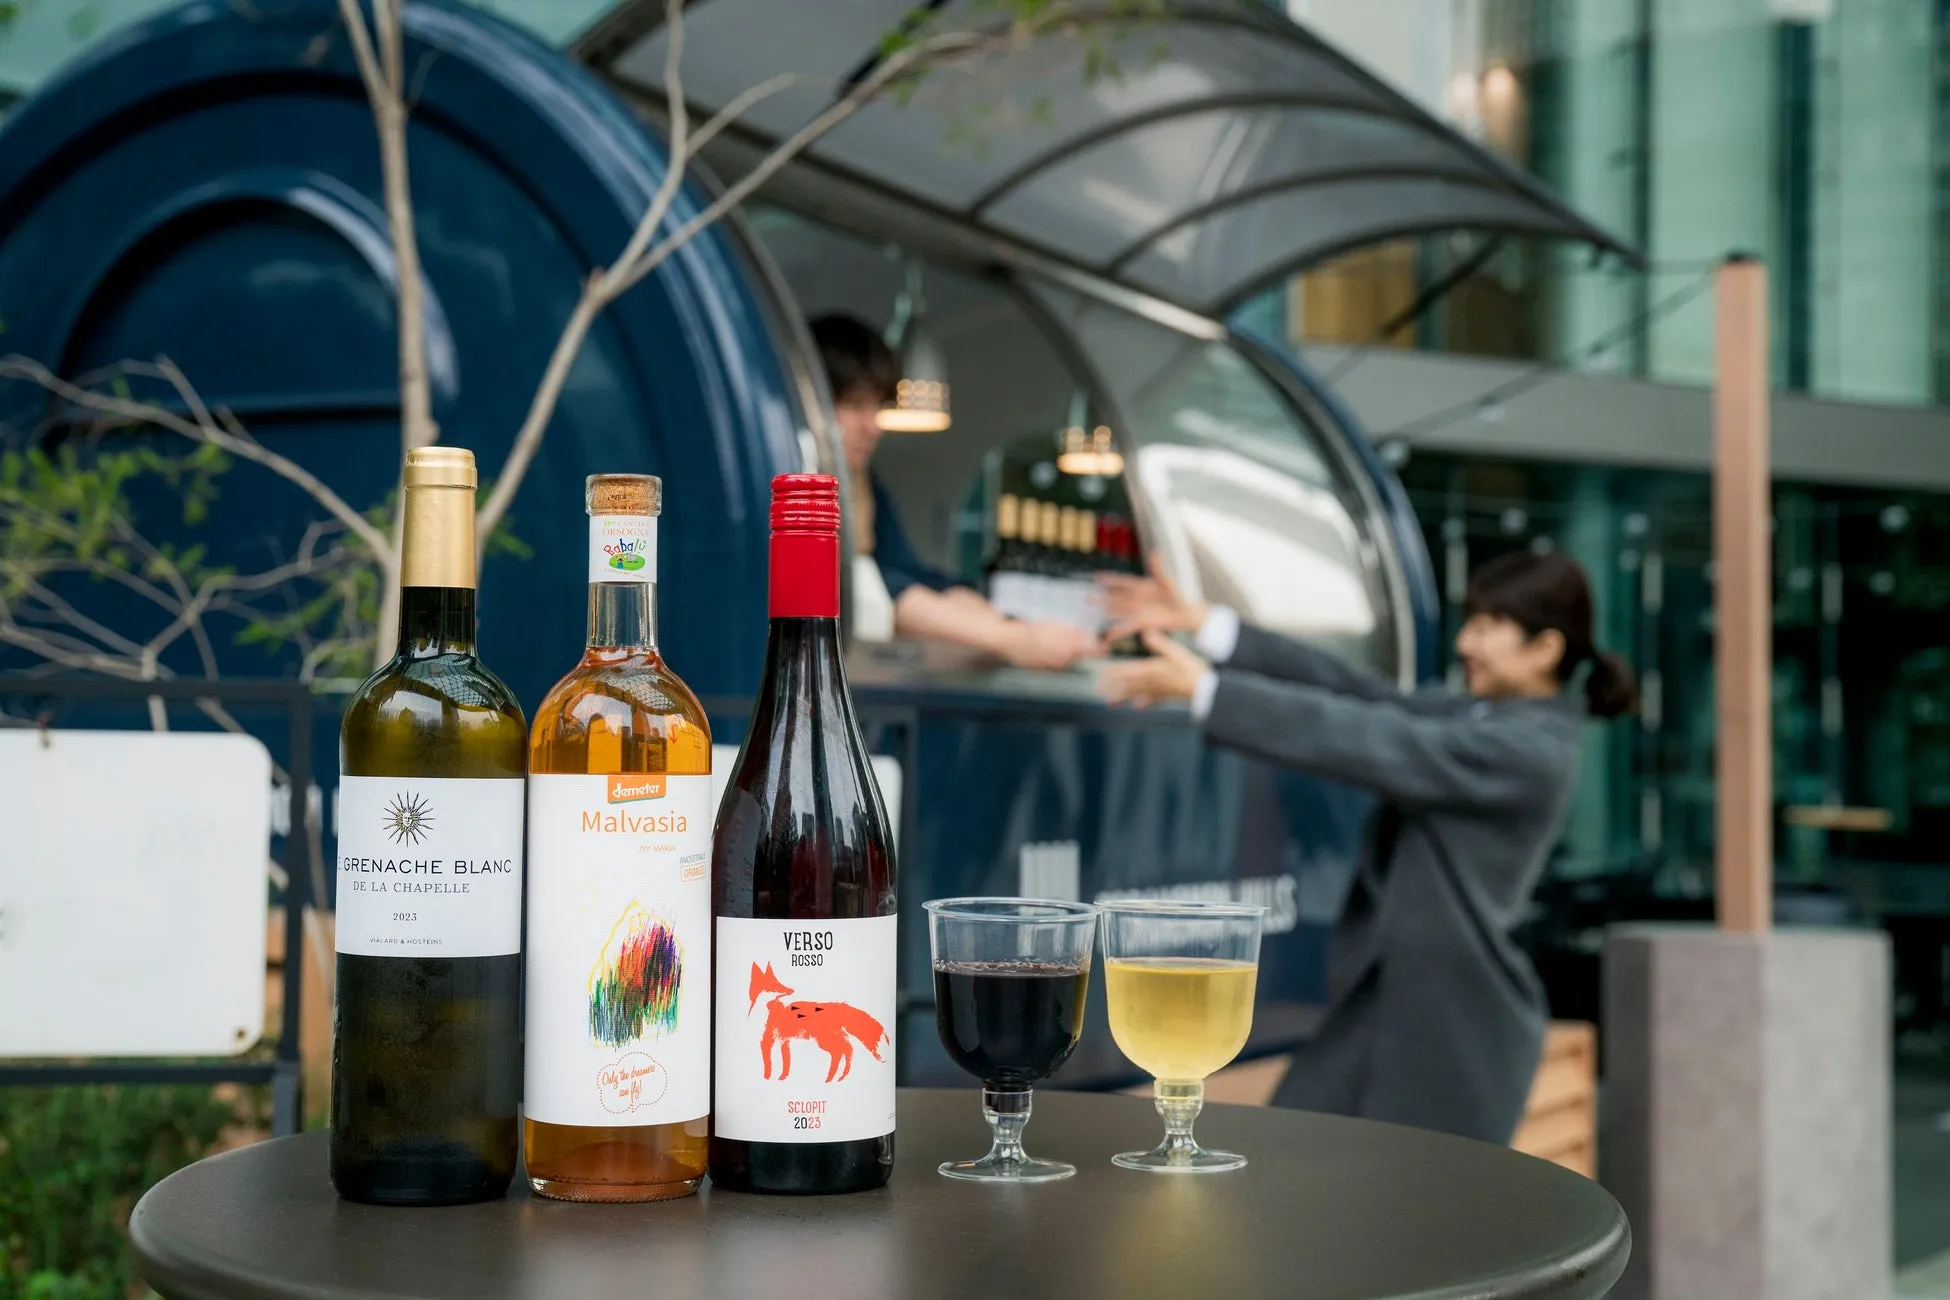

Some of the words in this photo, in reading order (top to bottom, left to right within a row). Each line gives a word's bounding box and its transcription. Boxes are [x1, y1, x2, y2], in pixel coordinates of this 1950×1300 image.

[602, 528, 649, 537] ORSOGNA
[612, 783, 660, 798] demeter
[582, 810, 687, 833] Malvasia
[343, 857, 443, 874] GRENACHE
[454, 859, 512, 874] BLANC
[353, 881, 367, 891] DE
[371, 882, 387, 892] LA
[393, 882, 470, 893] CHAPELLE
[393, 912, 417, 921] 2023
[784, 931, 833, 950] VERSO
[791, 954, 823, 966] ROSSO
[602, 1070, 619, 1089] Only
[619, 1067, 629, 1080] the
[787, 1101, 827, 1113] SCLOPIT
[794, 1116, 821, 1129] 2023
